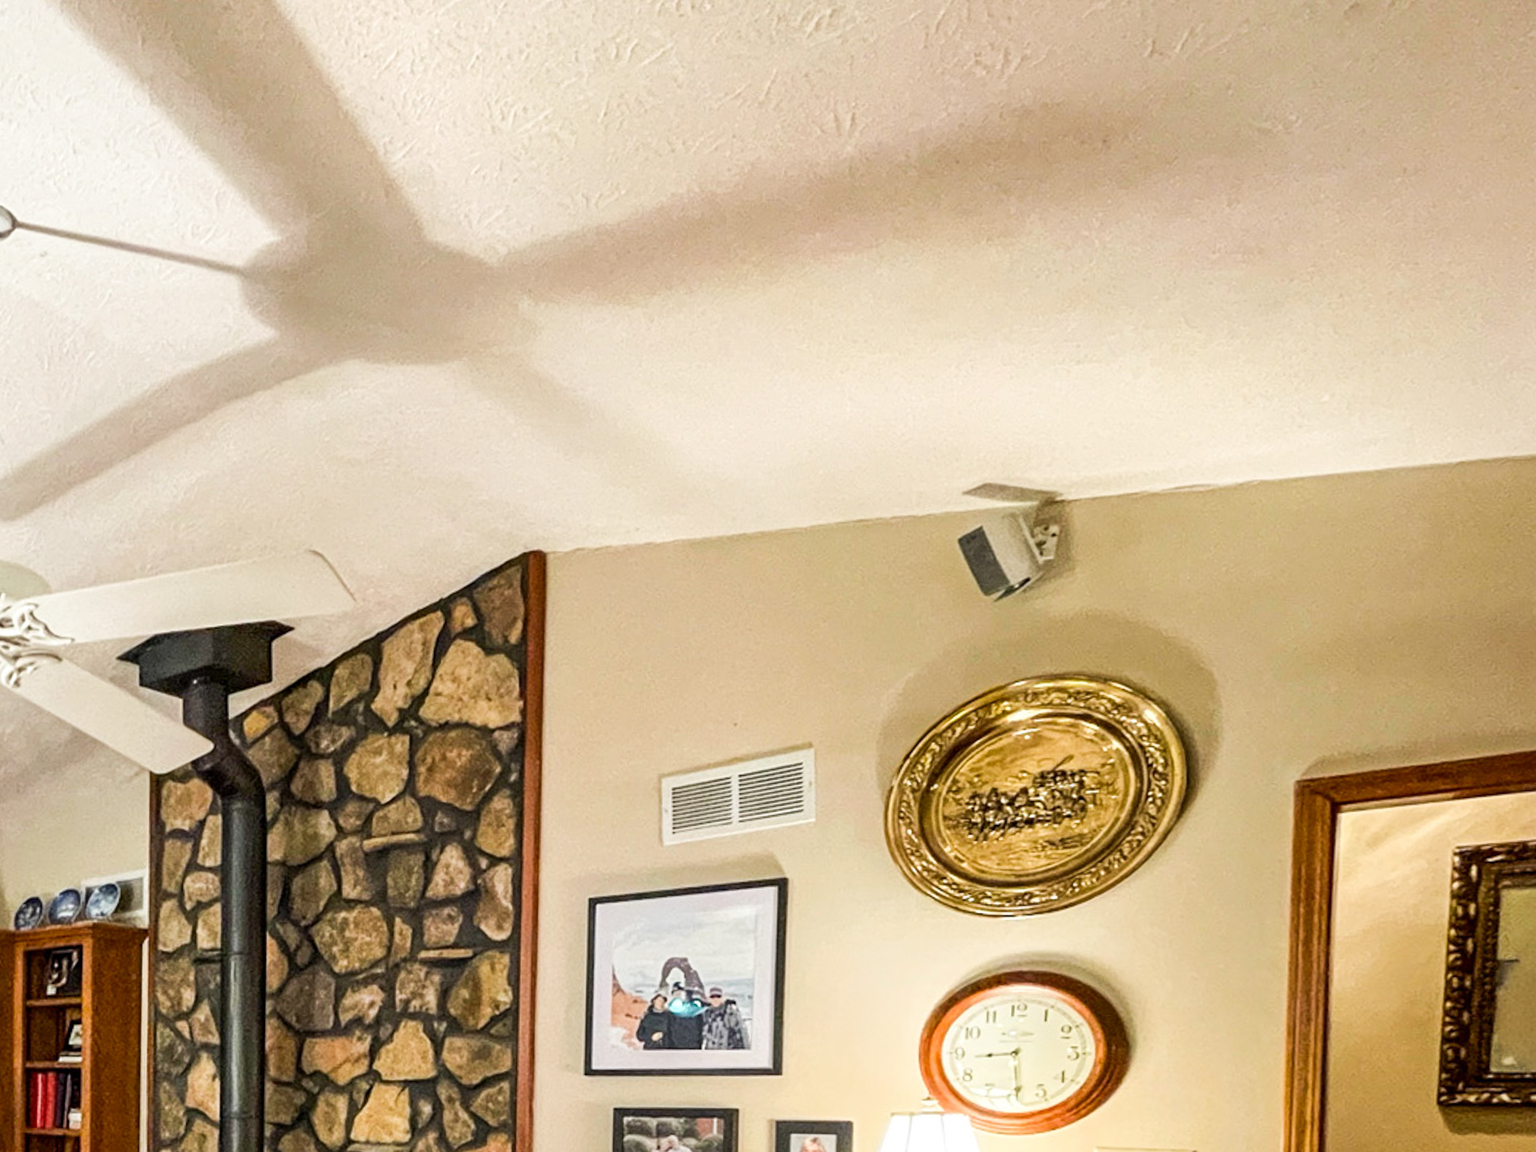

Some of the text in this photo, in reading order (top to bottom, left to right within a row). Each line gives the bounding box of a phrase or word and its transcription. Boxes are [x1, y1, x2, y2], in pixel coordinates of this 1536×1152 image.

[986, 1010, 997, 1024] 11
[1011, 1003, 1028, 1018] 12
[1044, 1008, 1049, 1023] 1
[965, 1026, 981, 1040] 10
[955, 1047, 966, 1061] 9
[962, 1068, 973, 1082] 8
[1035, 1084, 1047, 1098] 5
